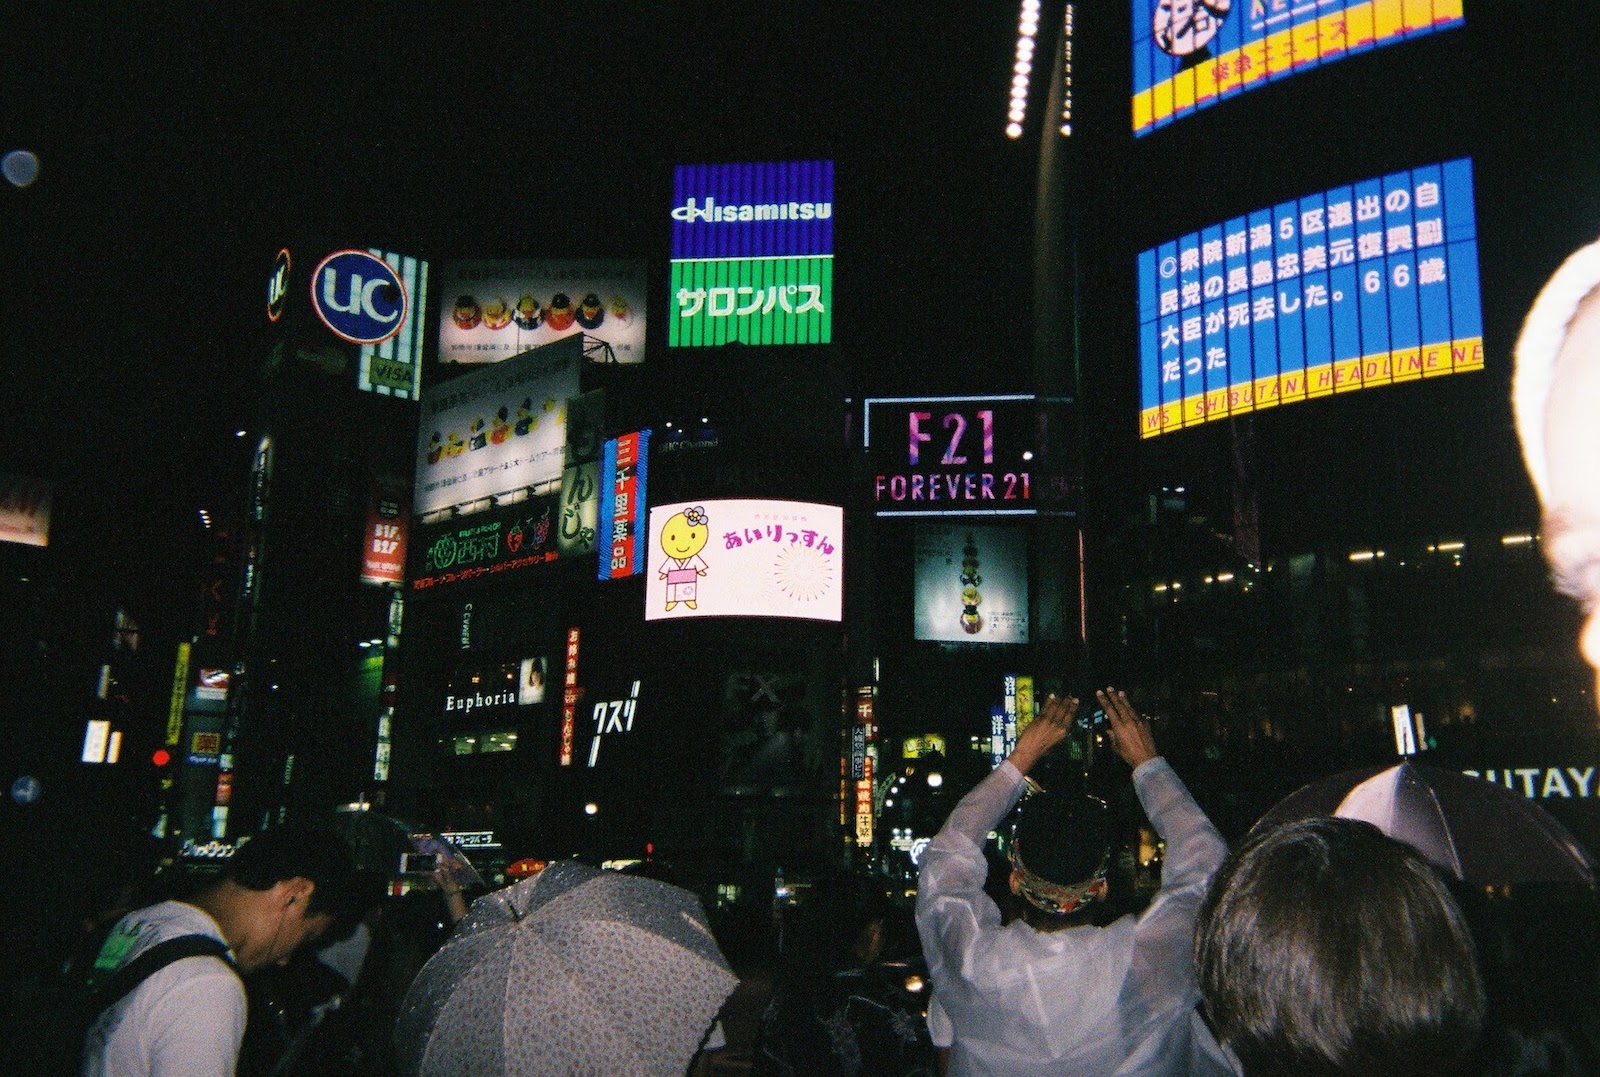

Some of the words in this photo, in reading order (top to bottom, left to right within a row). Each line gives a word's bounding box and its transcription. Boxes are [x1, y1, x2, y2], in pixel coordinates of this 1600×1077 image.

[671, 197, 831, 223] Hisamitsu
[676, 284, 825, 317] サロンパス
[1162, 347, 1227, 383] だった
[1318, 350, 1439, 387] HEADLINE
[909, 409, 993, 465] F21
[875, 473, 995, 501] FOREVER
[1003, 472, 1031, 500] 21
[611, 438, 633, 571] 三千里薬品
[723, 525, 835, 556] あいりっすん
[446, 689, 515, 713] Euphoria
